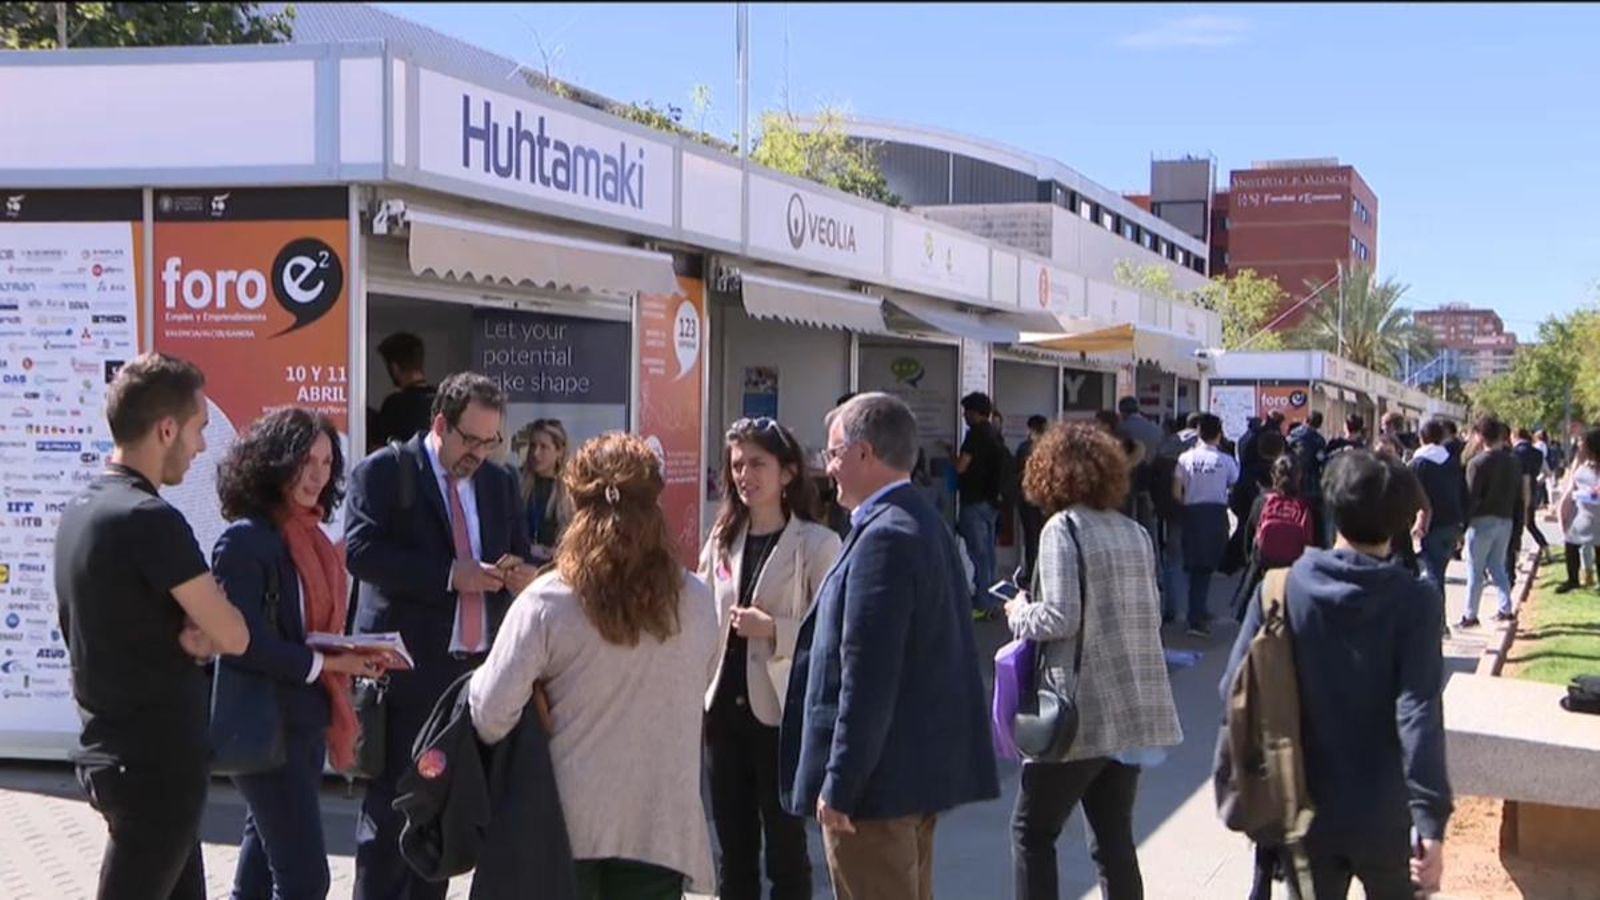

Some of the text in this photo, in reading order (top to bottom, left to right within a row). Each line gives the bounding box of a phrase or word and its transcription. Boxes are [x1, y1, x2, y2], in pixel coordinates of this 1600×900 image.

[462, 94, 644, 210] Huhtamaki
[808, 213, 857, 253] VEOLIA
[161, 256, 267, 310] foro
[483, 319, 568, 347] Let your
[679, 318, 697, 338] 123
[483, 346, 573, 369] potential
[285, 366, 347, 382] 10 Y 11
[531, 371, 590, 398] shape
[296, 386, 347, 402] ABRIL
[1064, 374, 1086, 404] Y
[1262, 393, 1289, 406] foro
